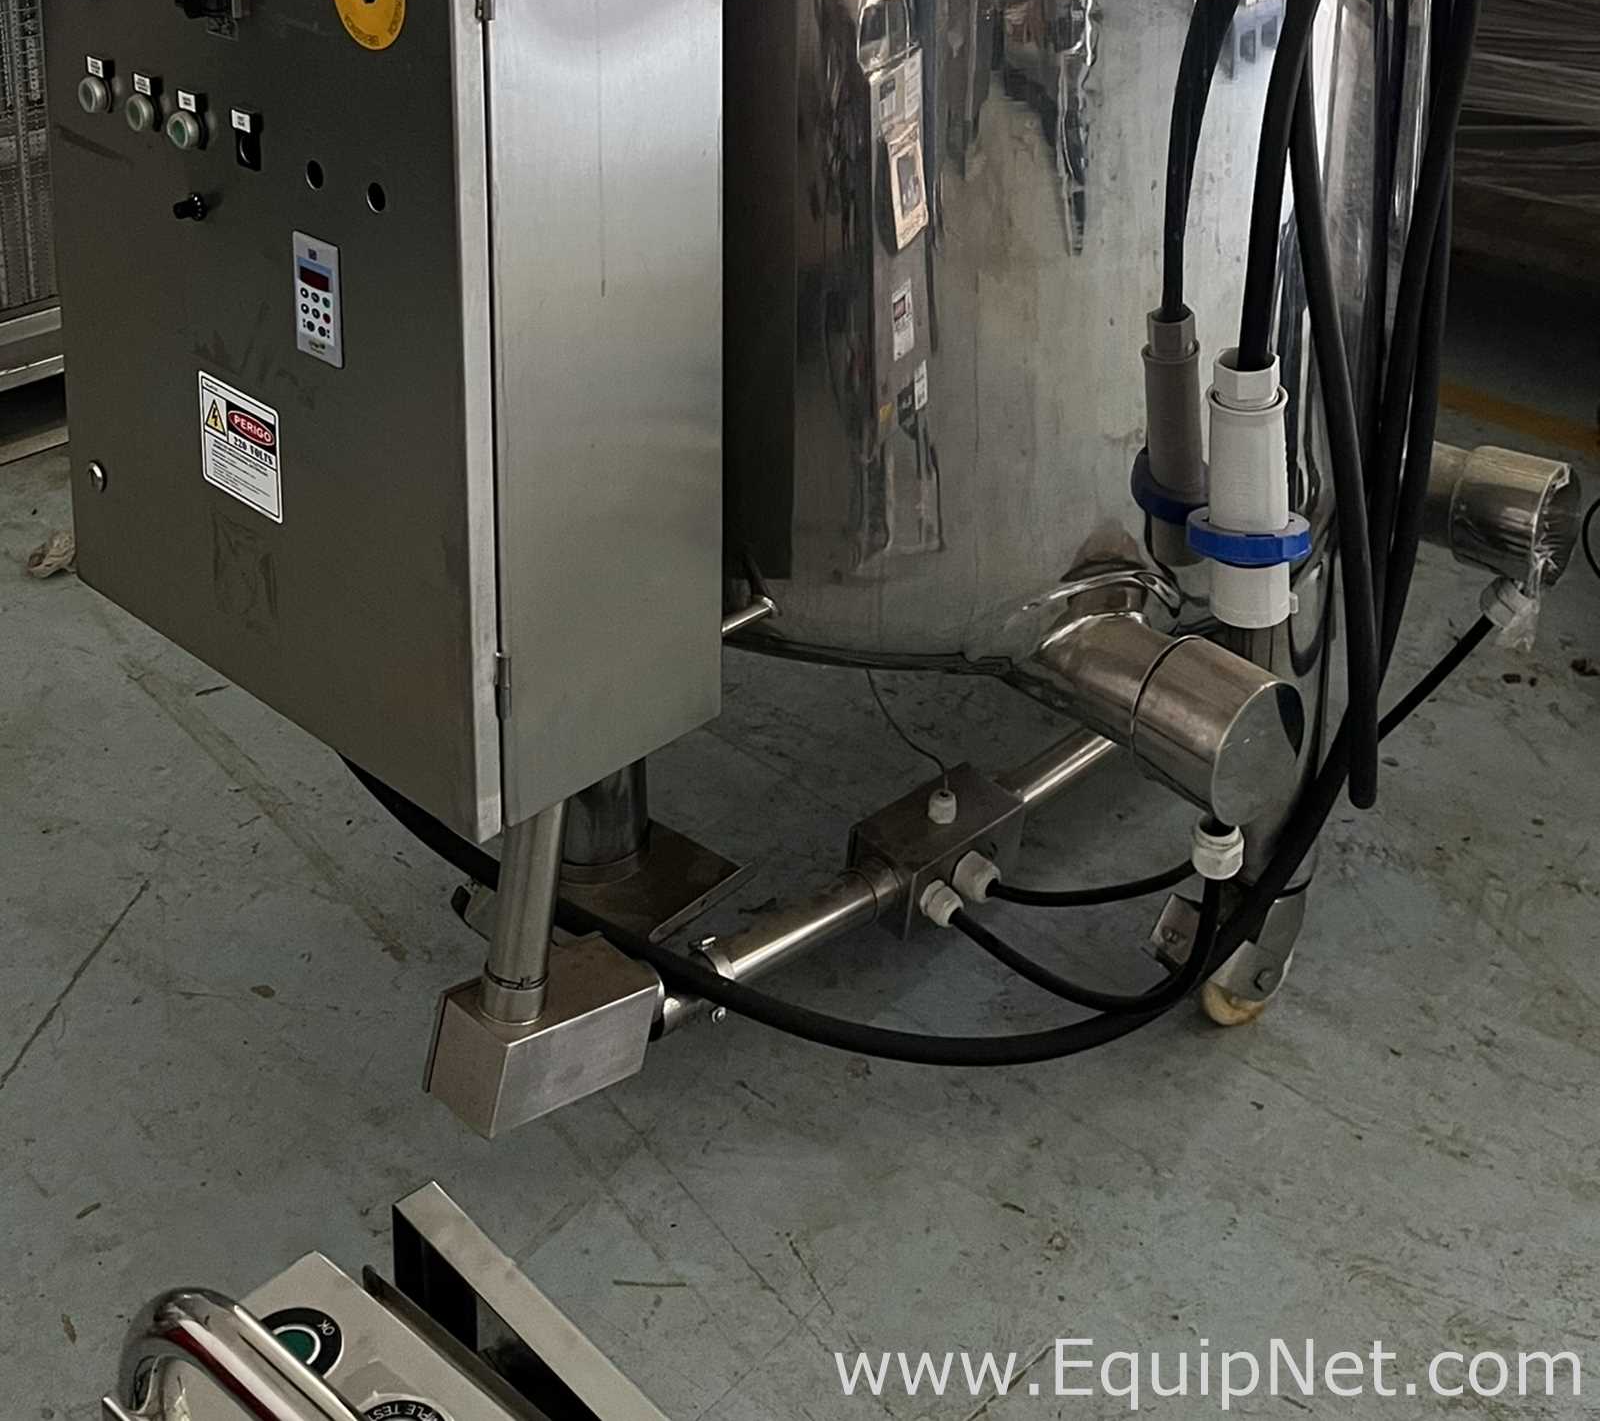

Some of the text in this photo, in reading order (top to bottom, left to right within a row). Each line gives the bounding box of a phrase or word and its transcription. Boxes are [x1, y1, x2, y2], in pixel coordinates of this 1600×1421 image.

[233, 414, 272, 443] PERIGO
[233, 436, 273, 466] 220 VOLTS
[317, 1319, 335, 1336] OK
